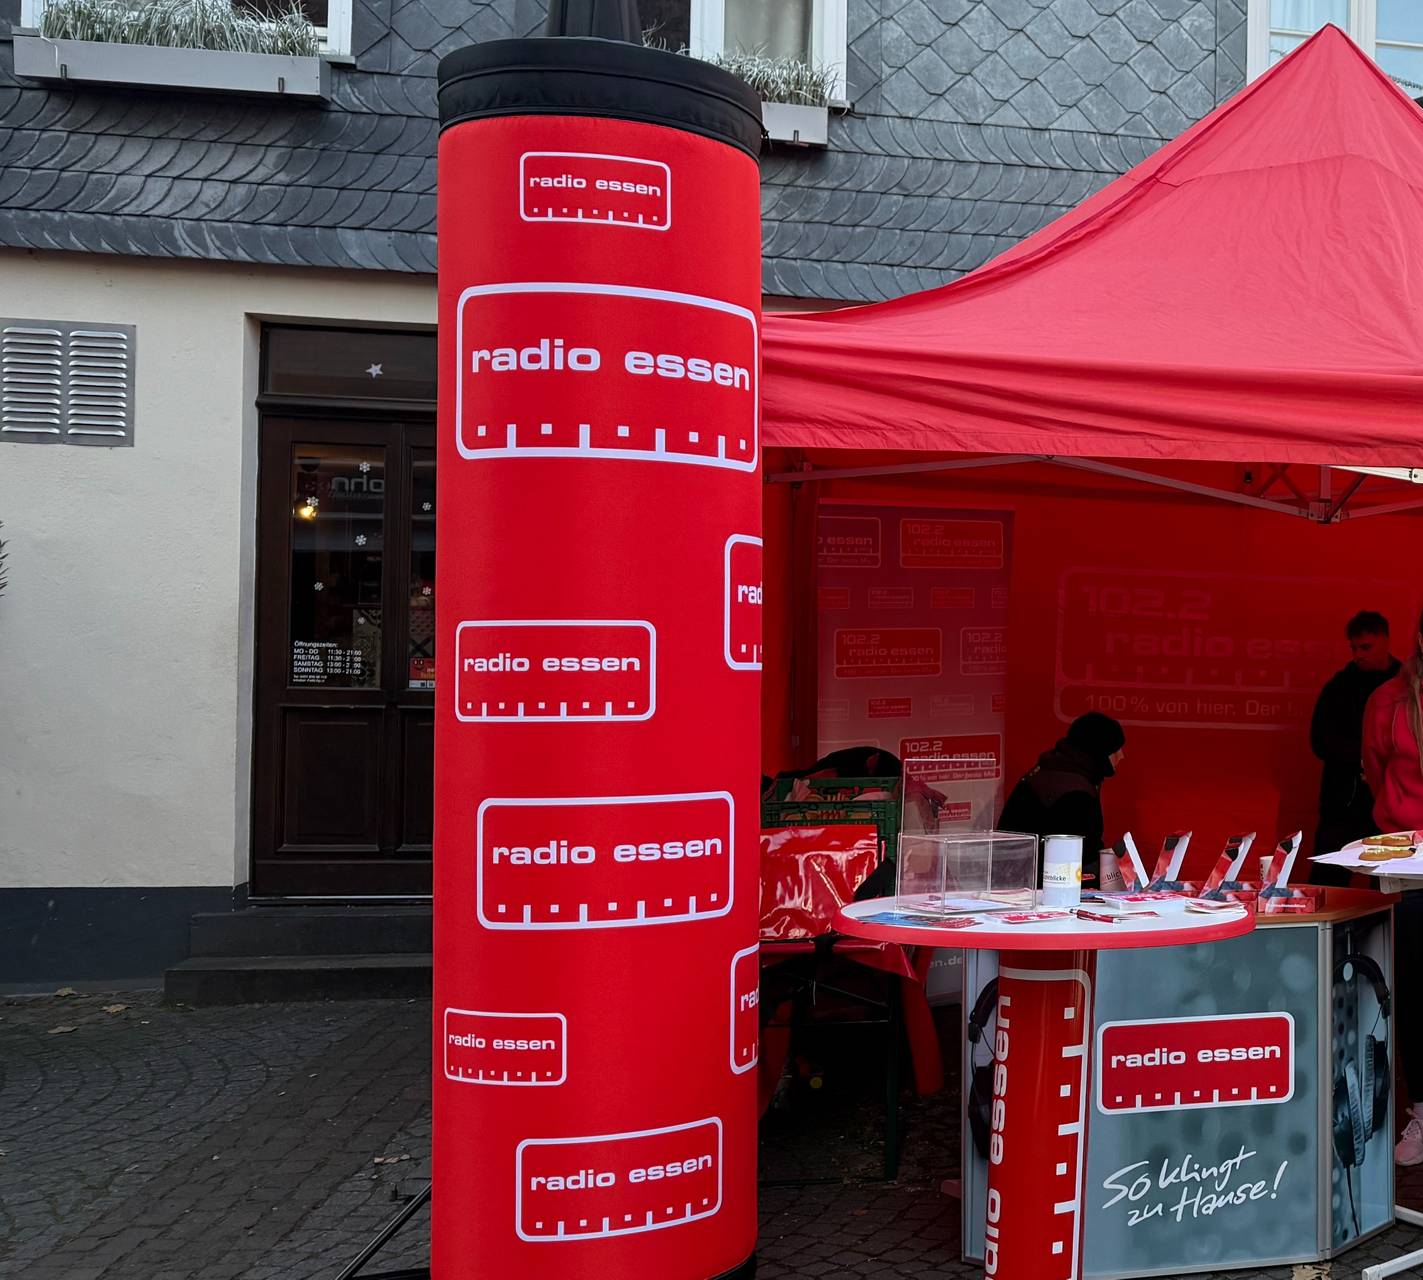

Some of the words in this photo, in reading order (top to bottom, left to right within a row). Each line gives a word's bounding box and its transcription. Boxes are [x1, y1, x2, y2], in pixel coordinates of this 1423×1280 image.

[529, 174, 587, 189] radio
[595, 179, 661, 197] essen
[471, 338, 601, 373] radio
[624, 350, 750, 391] essen
[737, 581, 763, 605] rad
[1080, 585, 1213, 621] 102.2
[841, 633, 881, 646] 102.2
[848, 646, 889, 657] radio
[890, 647, 934, 656] essen
[1105, 627, 1234, 658] radio
[463, 652, 530, 672] radio
[542, 657, 641, 672] essen
[1156, 699, 1189, 714] von
[1196, 696, 1237, 716] hier.
[1245, 699, 1281, 717] Der
[904, 740, 944, 753] 102.2
[492, 839, 596, 865] radio
[613, 837, 722, 863] essen
[448, 1033, 486, 1049] radio
[492, 1039, 556, 1051] essen
[1111, 1047, 1187, 1069] radio
[1197, 1045, 1281, 1063] essen
[989, 994, 1012, 1166] essen
[530, 1168, 616, 1191] radio
[628, 1154, 712, 1183] essen
[1102, 1160, 1152, 1209] So
[1158, 1145, 1257, 1192] klingt
[1127, 1202, 1164, 1227] zu
[1169, 1160, 1289, 1223] Hause!
[984, 1187, 1001, 1280] dio
